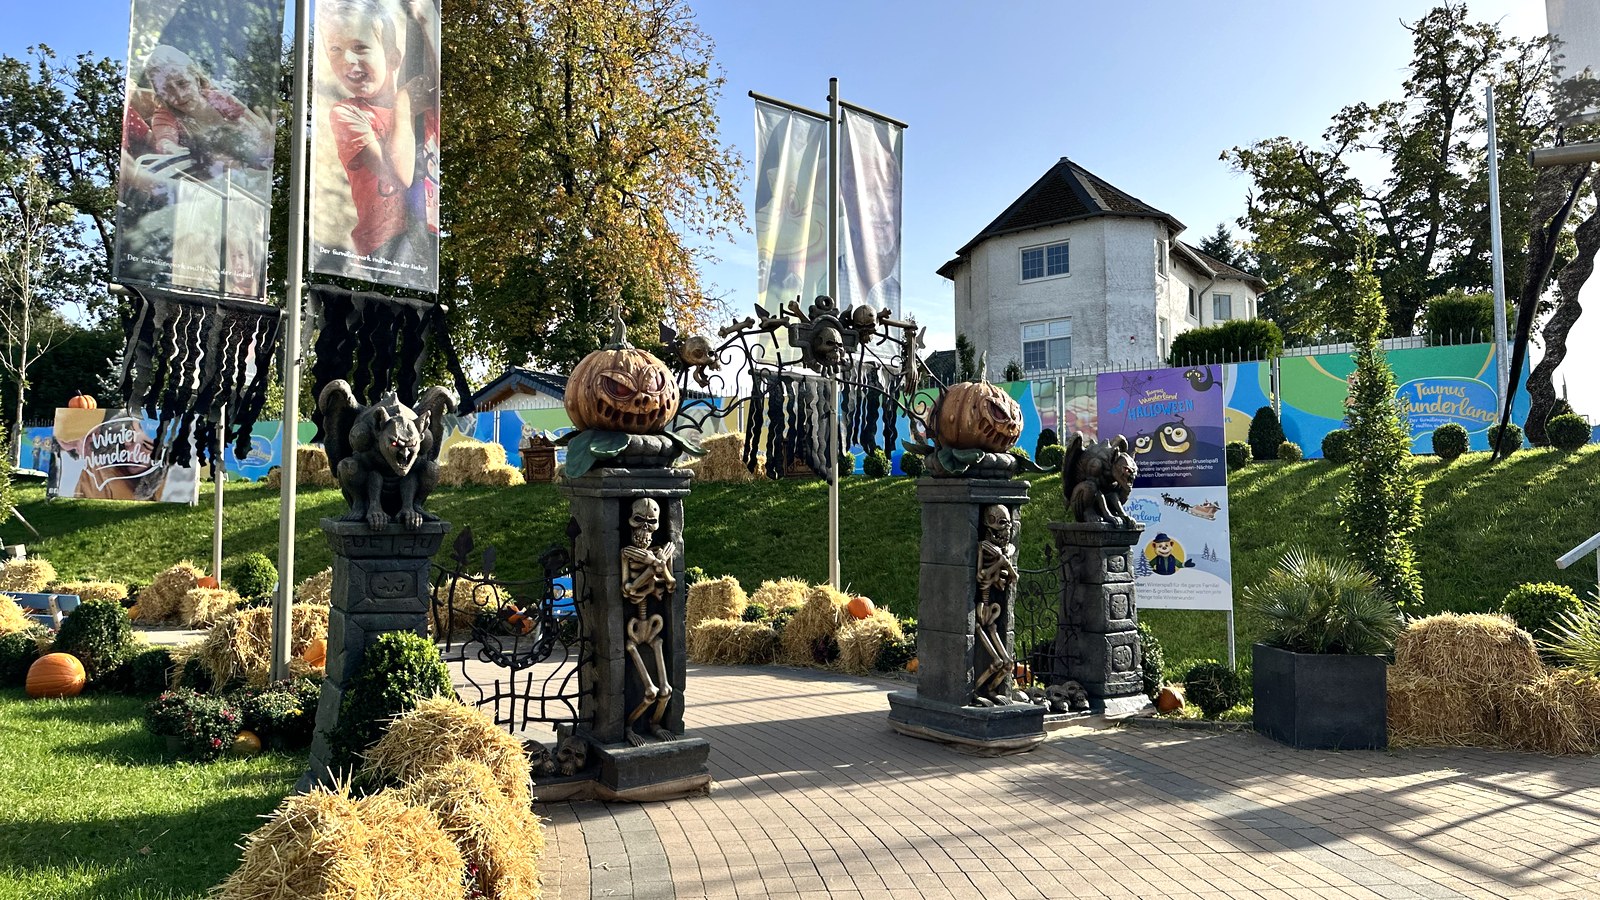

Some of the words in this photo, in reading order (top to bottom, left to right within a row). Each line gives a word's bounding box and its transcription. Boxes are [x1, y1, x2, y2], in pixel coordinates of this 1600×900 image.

[320, 246, 330, 254] Der
[127, 253, 139, 262] Der
[1413, 383, 1466, 400] Taunus
[1138, 392, 1178, 405] Wunderland
[1128, 399, 1194, 421] HALLOWEEN
[92, 423, 140, 449] Winter
[1192, 457, 1219, 465] Gruselspaß
